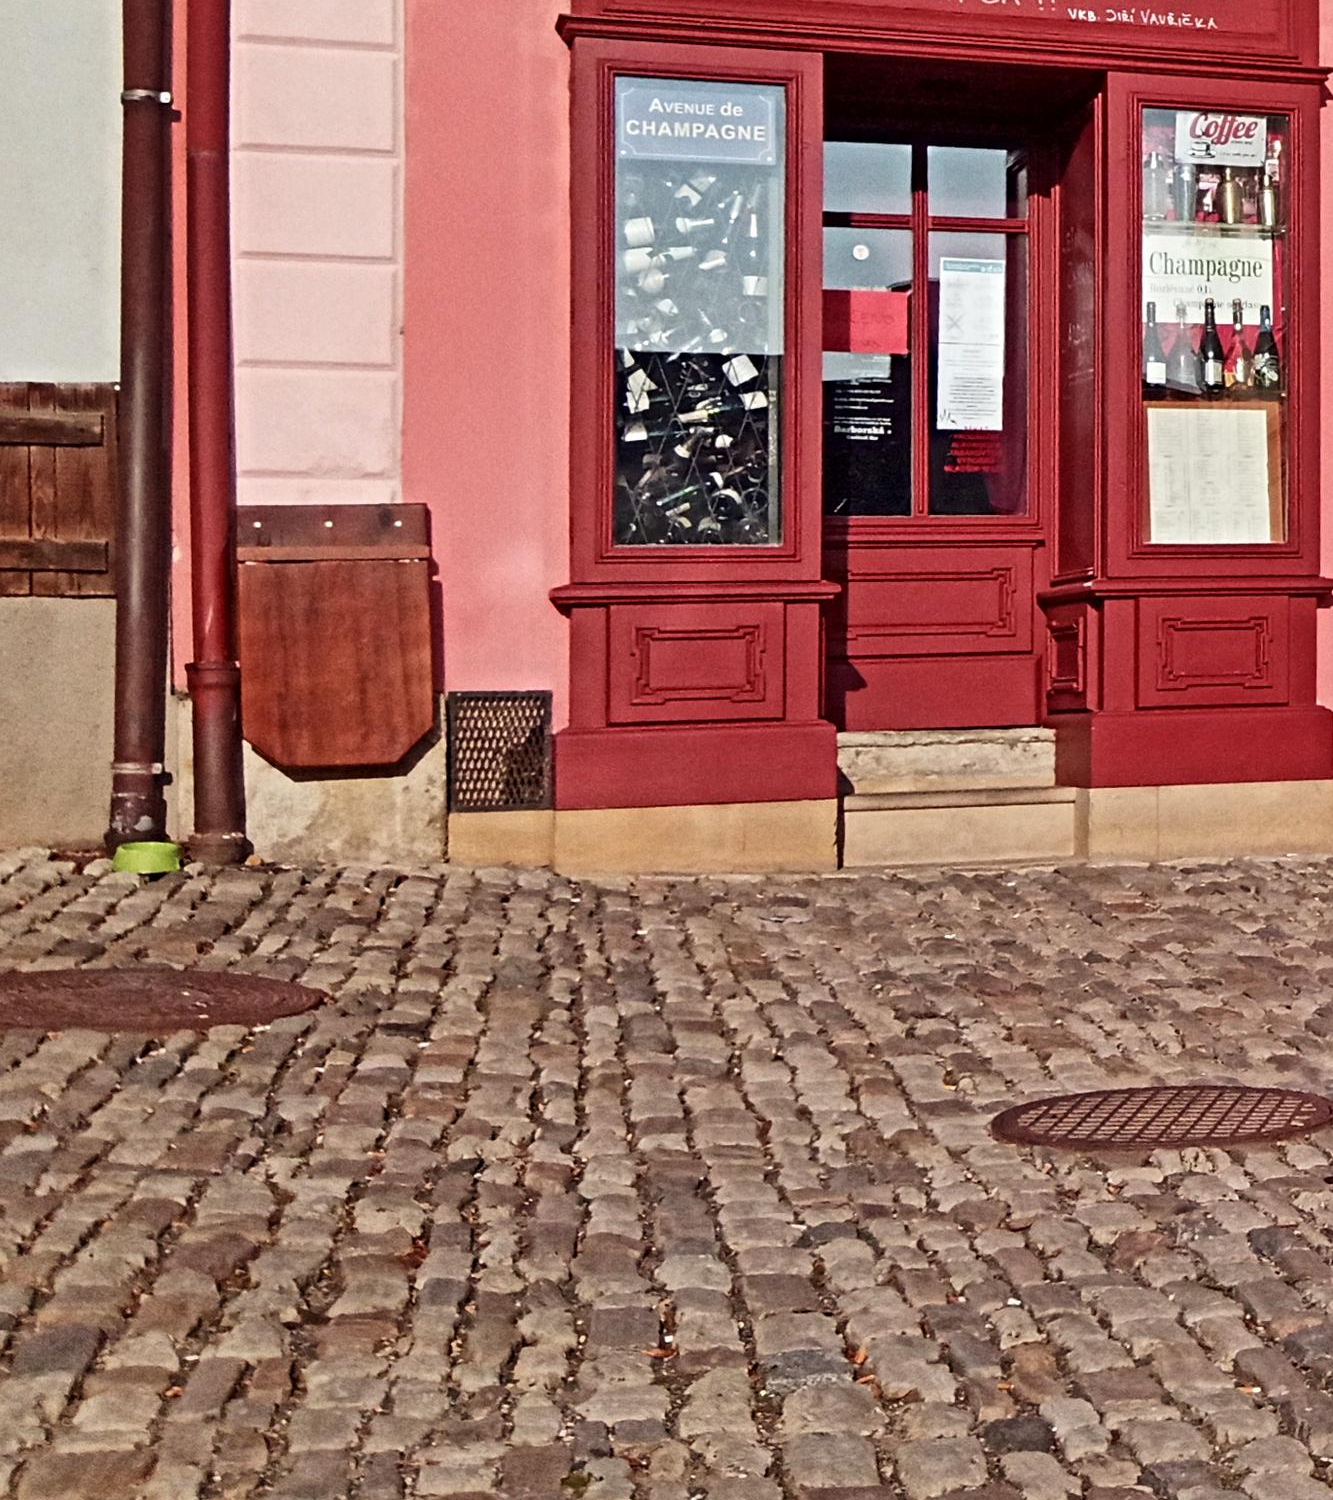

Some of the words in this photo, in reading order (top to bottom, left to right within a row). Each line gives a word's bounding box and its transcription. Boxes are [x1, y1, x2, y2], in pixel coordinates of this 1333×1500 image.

[720, 102, 743, 116] de
[626, 119, 766, 141] CHAMPAGNE
[1190, 112, 1258, 145] Coffee
[1150, 251, 1263, 283] Champagne
